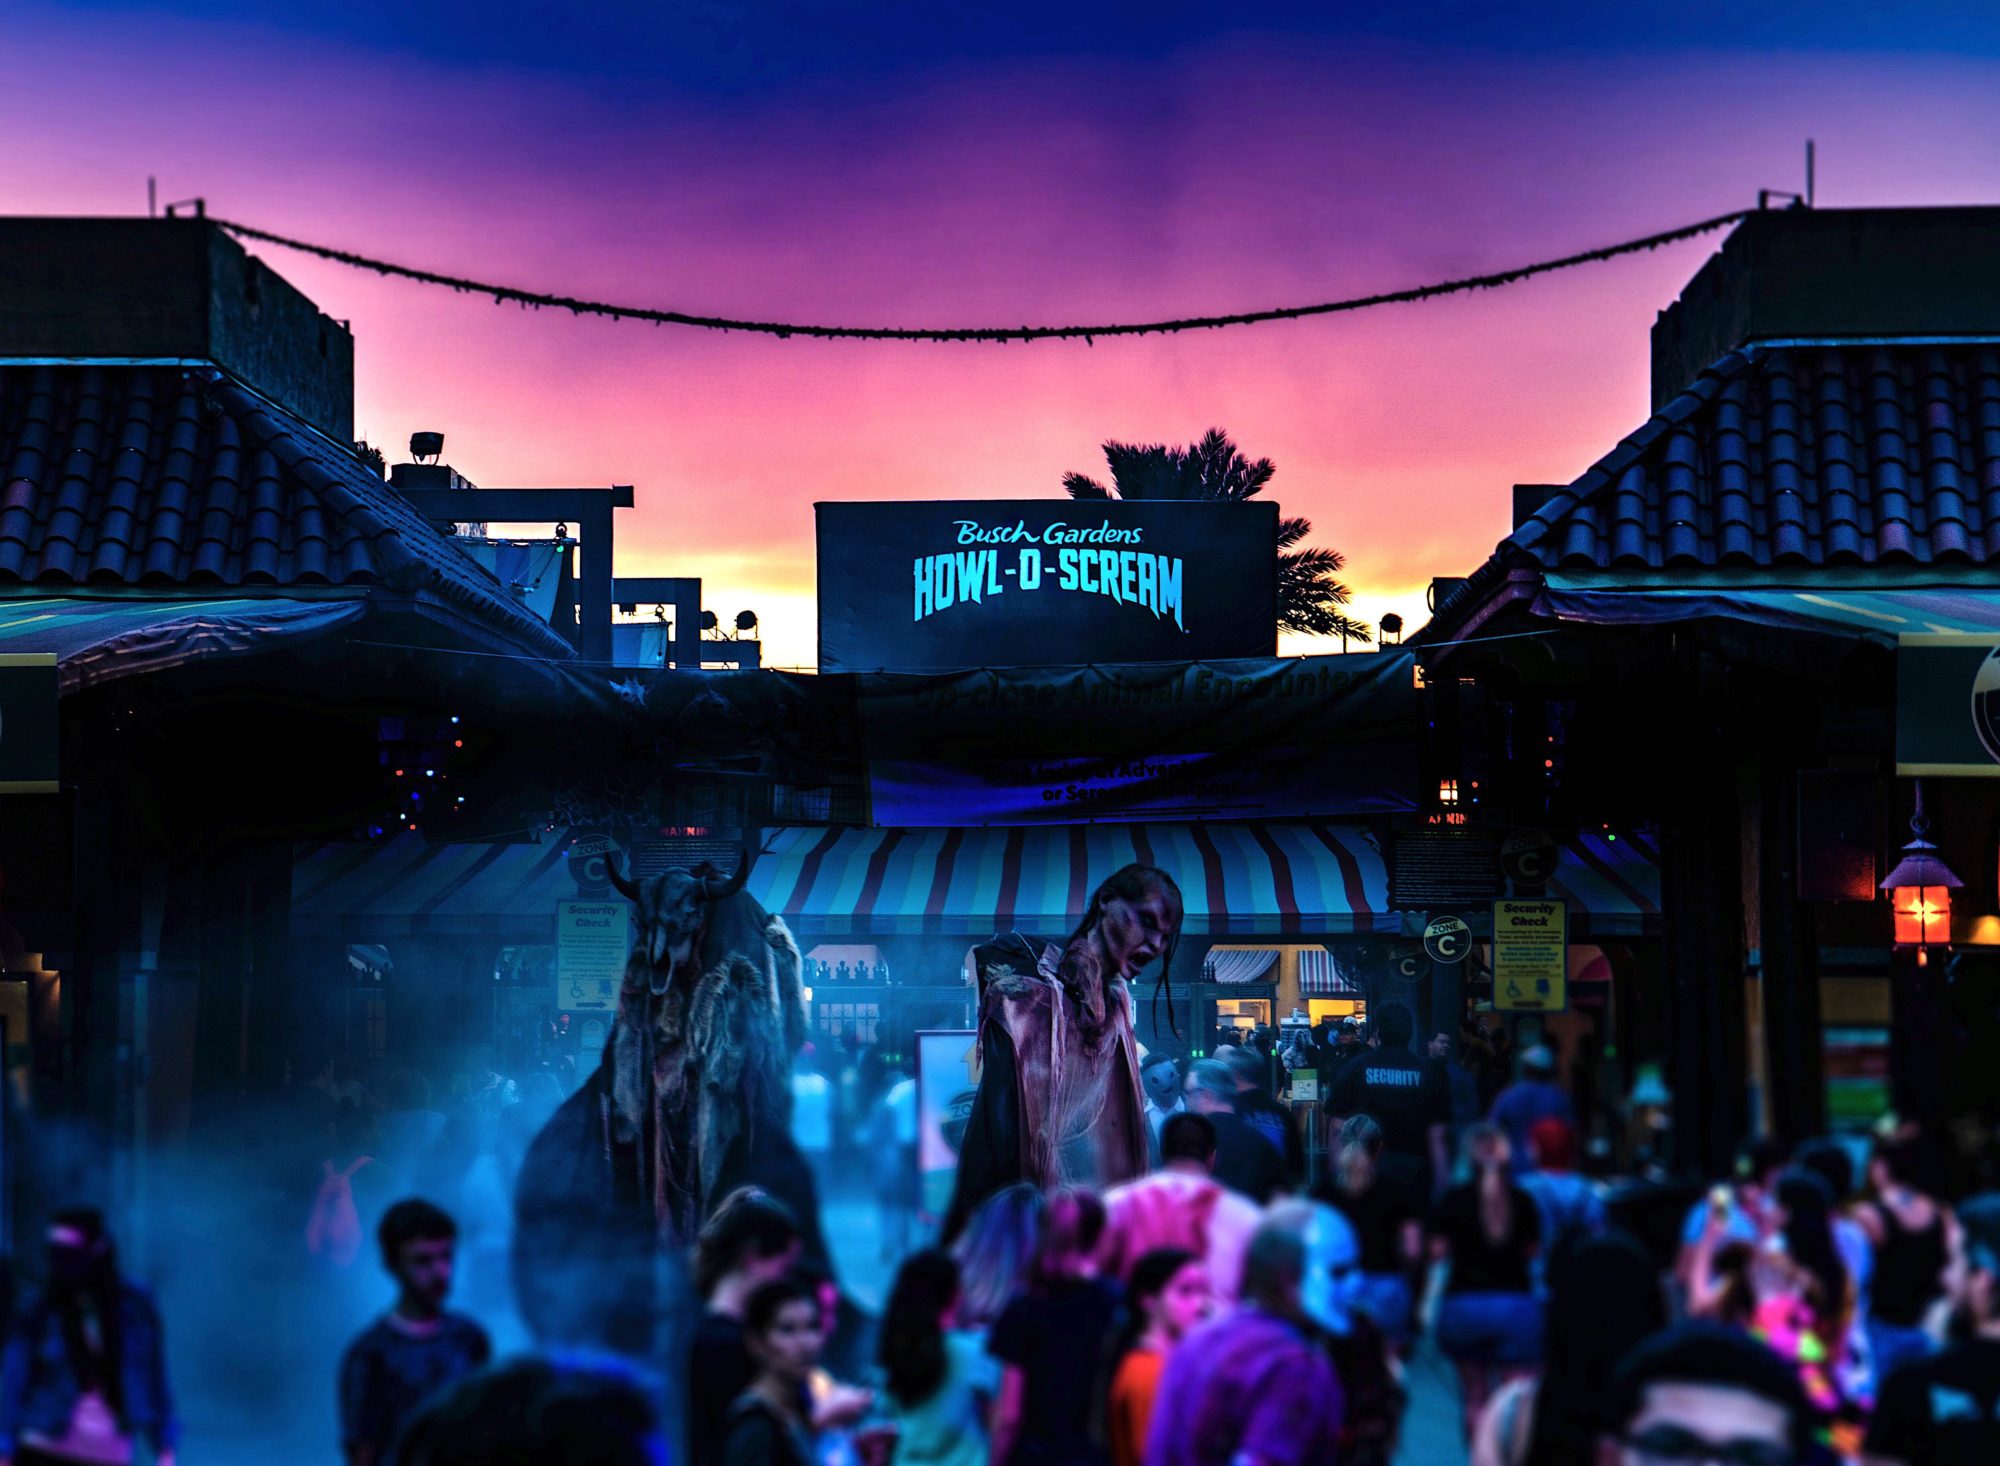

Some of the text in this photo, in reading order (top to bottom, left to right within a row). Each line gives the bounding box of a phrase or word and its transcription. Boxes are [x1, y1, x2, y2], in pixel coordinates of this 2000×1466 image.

[953, 519, 1143, 545] Busch Gardens
[913, 549, 1184, 632] HOWL-O-SCREAM
[1062, 668, 1186, 706] Animal
[1194, 665, 1379, 702] Encounters
[1042, 788, 1063, 802] or
[584, 857, 606, 881] C
[1518, 852, 1541, 877] C
[567, 904, 619, 917] Security
[1503, 903, 1556, 916] Security
[575, 918, 612, 928] Check
[1431, 921, 1459, 935] ZONE
[1510, 916, 1549, 927] Check
[1437, 935, 1457, 956] C
[1399, 957, 1417, 976] C
[1365, 1067, 1421, 1087] SECURITY
